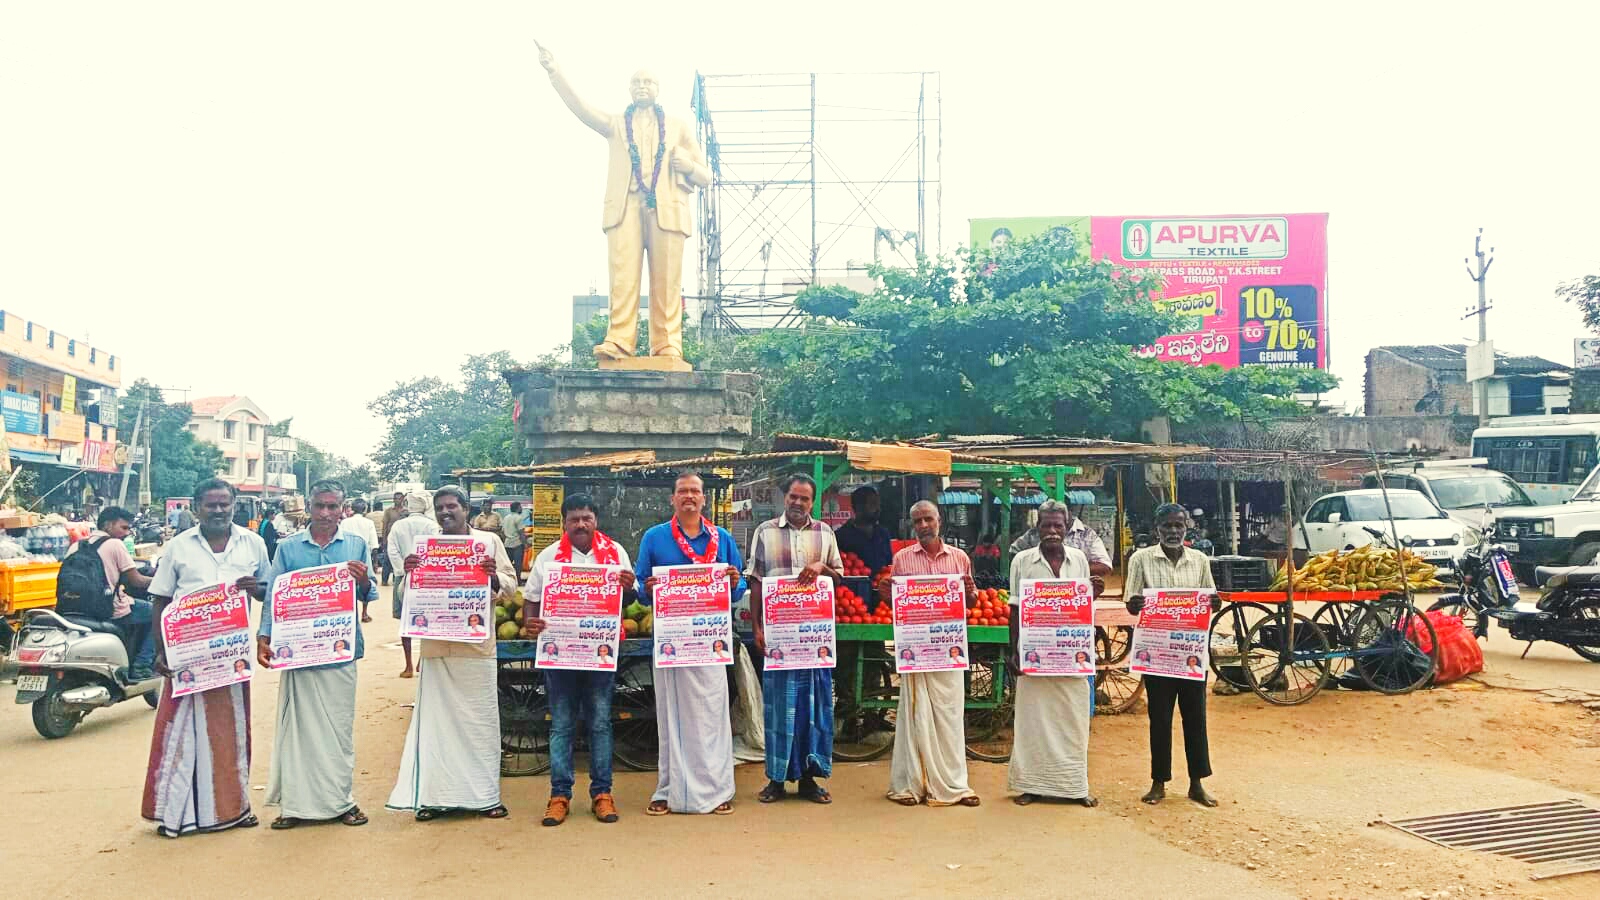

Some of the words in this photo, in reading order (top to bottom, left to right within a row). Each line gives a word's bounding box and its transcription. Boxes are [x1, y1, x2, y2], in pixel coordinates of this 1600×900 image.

[1155, 224, 1281, 244] APURVA
[1188, 247, 1249, 256] TEXTILE
[1187, 267, 1215, 276] ROAD
[1228, 266, 1283, 275] T.K.STREET
[1183, 275, 1227, 284] TIRUPATI
[1241, 288, 1293, 319] 10%
[1245, 327, 1262, 338] to
[1264, 320, 1316, 350] 70%
[1259, 351, 1298, 361] GENUINE
